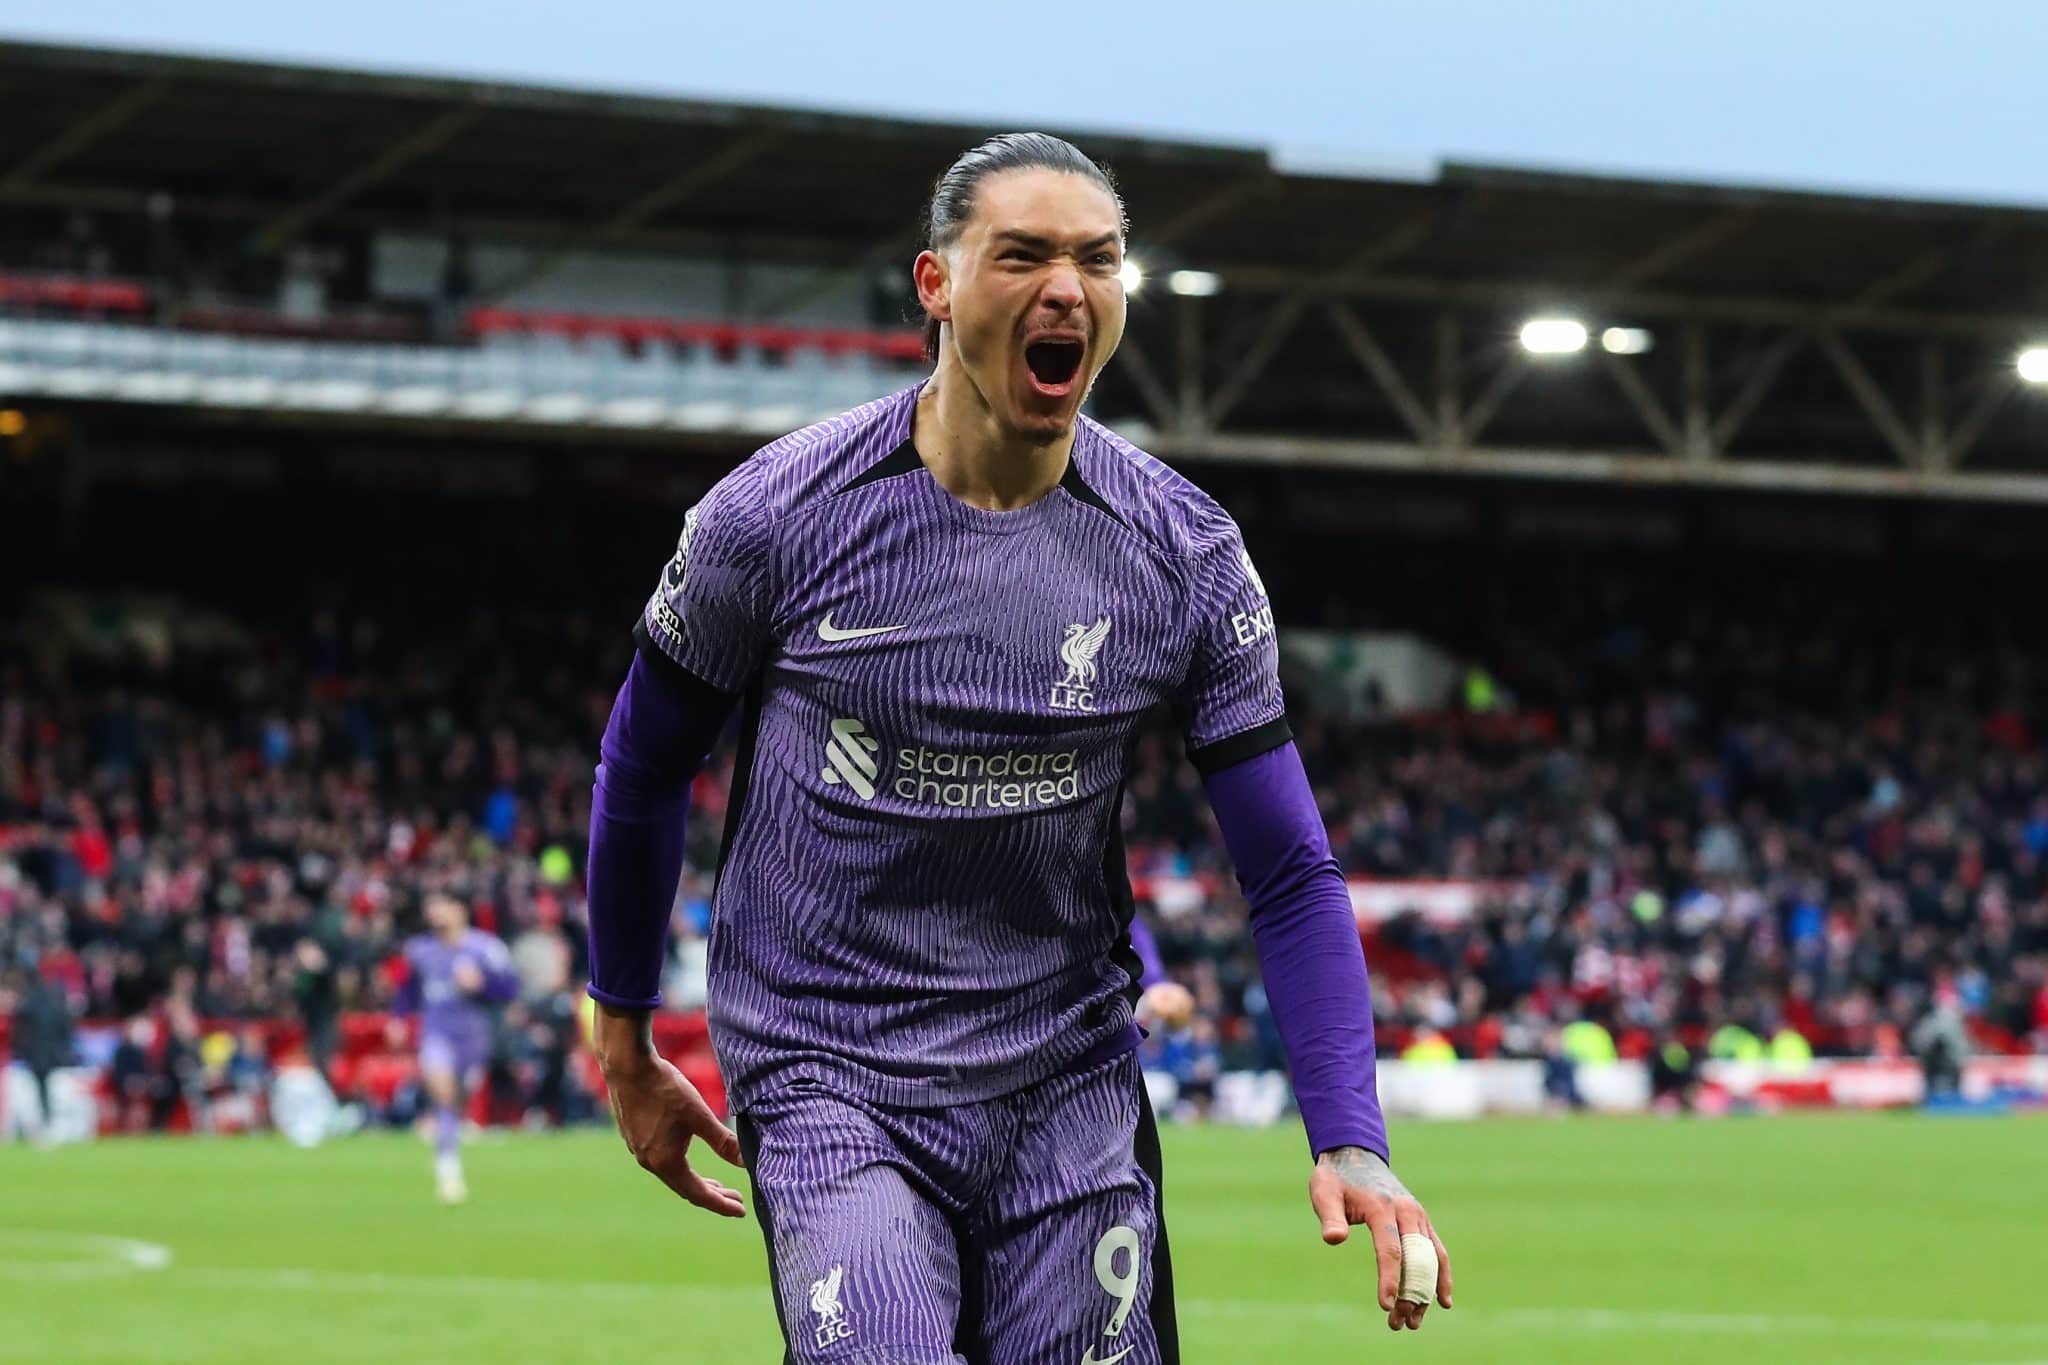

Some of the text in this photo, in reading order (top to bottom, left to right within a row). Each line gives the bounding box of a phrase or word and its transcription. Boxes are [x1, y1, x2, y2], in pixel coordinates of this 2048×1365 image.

[898, 747, 1078, 777] standard
[895, 770, 1079, 808] chartered
[1094, 1226, 1140, 1336] 9
